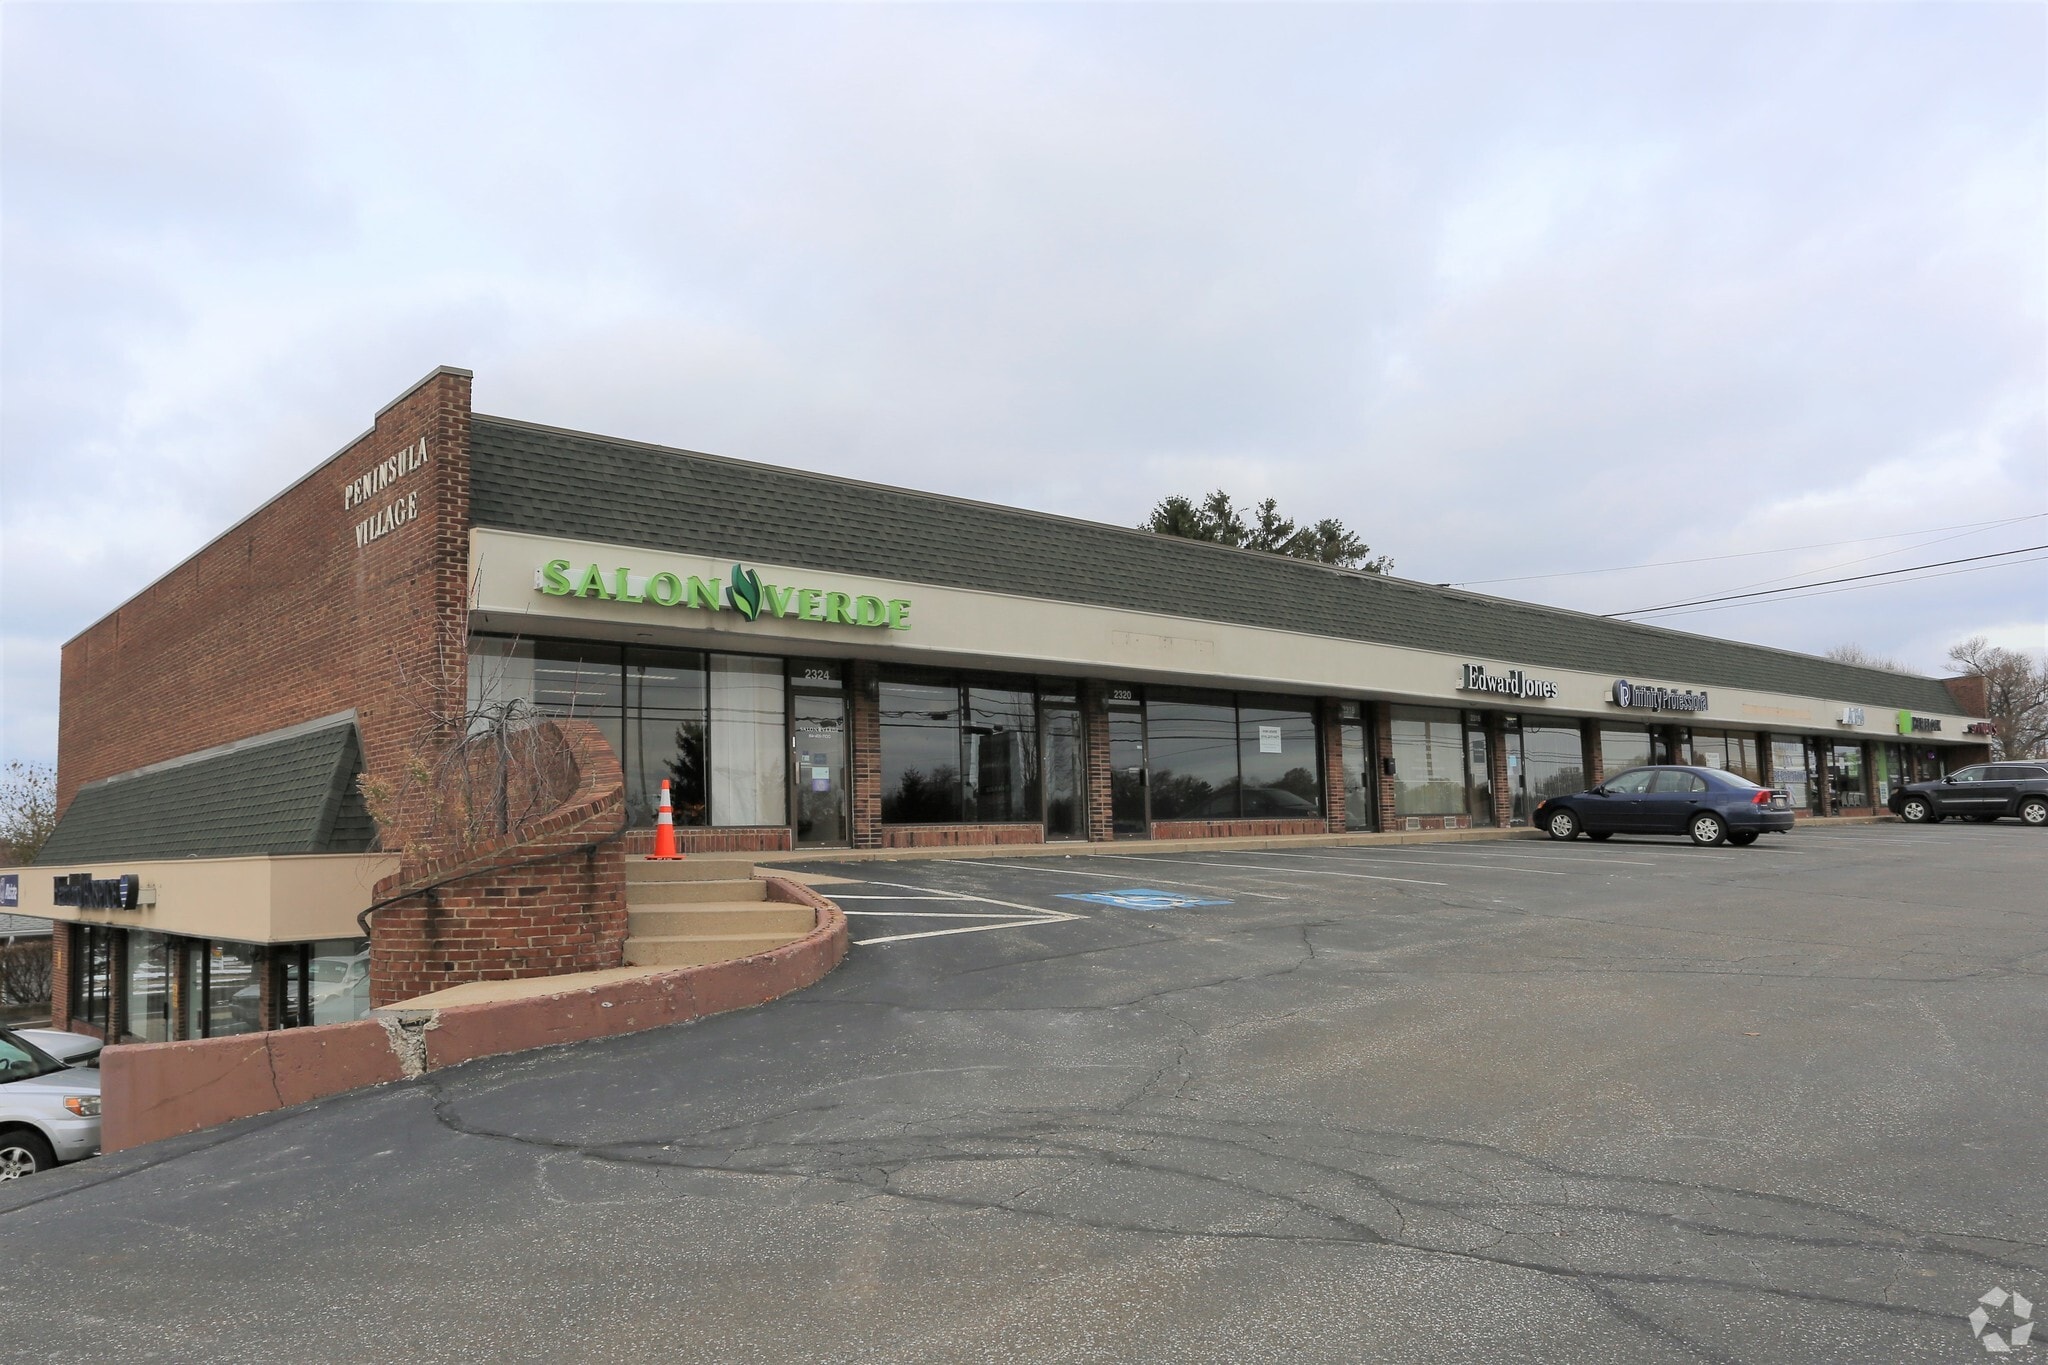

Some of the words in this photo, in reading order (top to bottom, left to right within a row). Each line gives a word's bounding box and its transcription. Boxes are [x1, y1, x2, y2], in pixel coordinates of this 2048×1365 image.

[344, 436, 428, 511] PENINSULA
[355, 491, 419, 549] VILLAGE
[543, 559, 722, 611] SALON
[764, 583, 912, 631] VERDE
[805, 668, 830, 680] 2324
[1114, 690, 1132, 700] 2320
[1464, 663, 1519, 696] Edward
[1520, 670, 1558, 699] Jones
